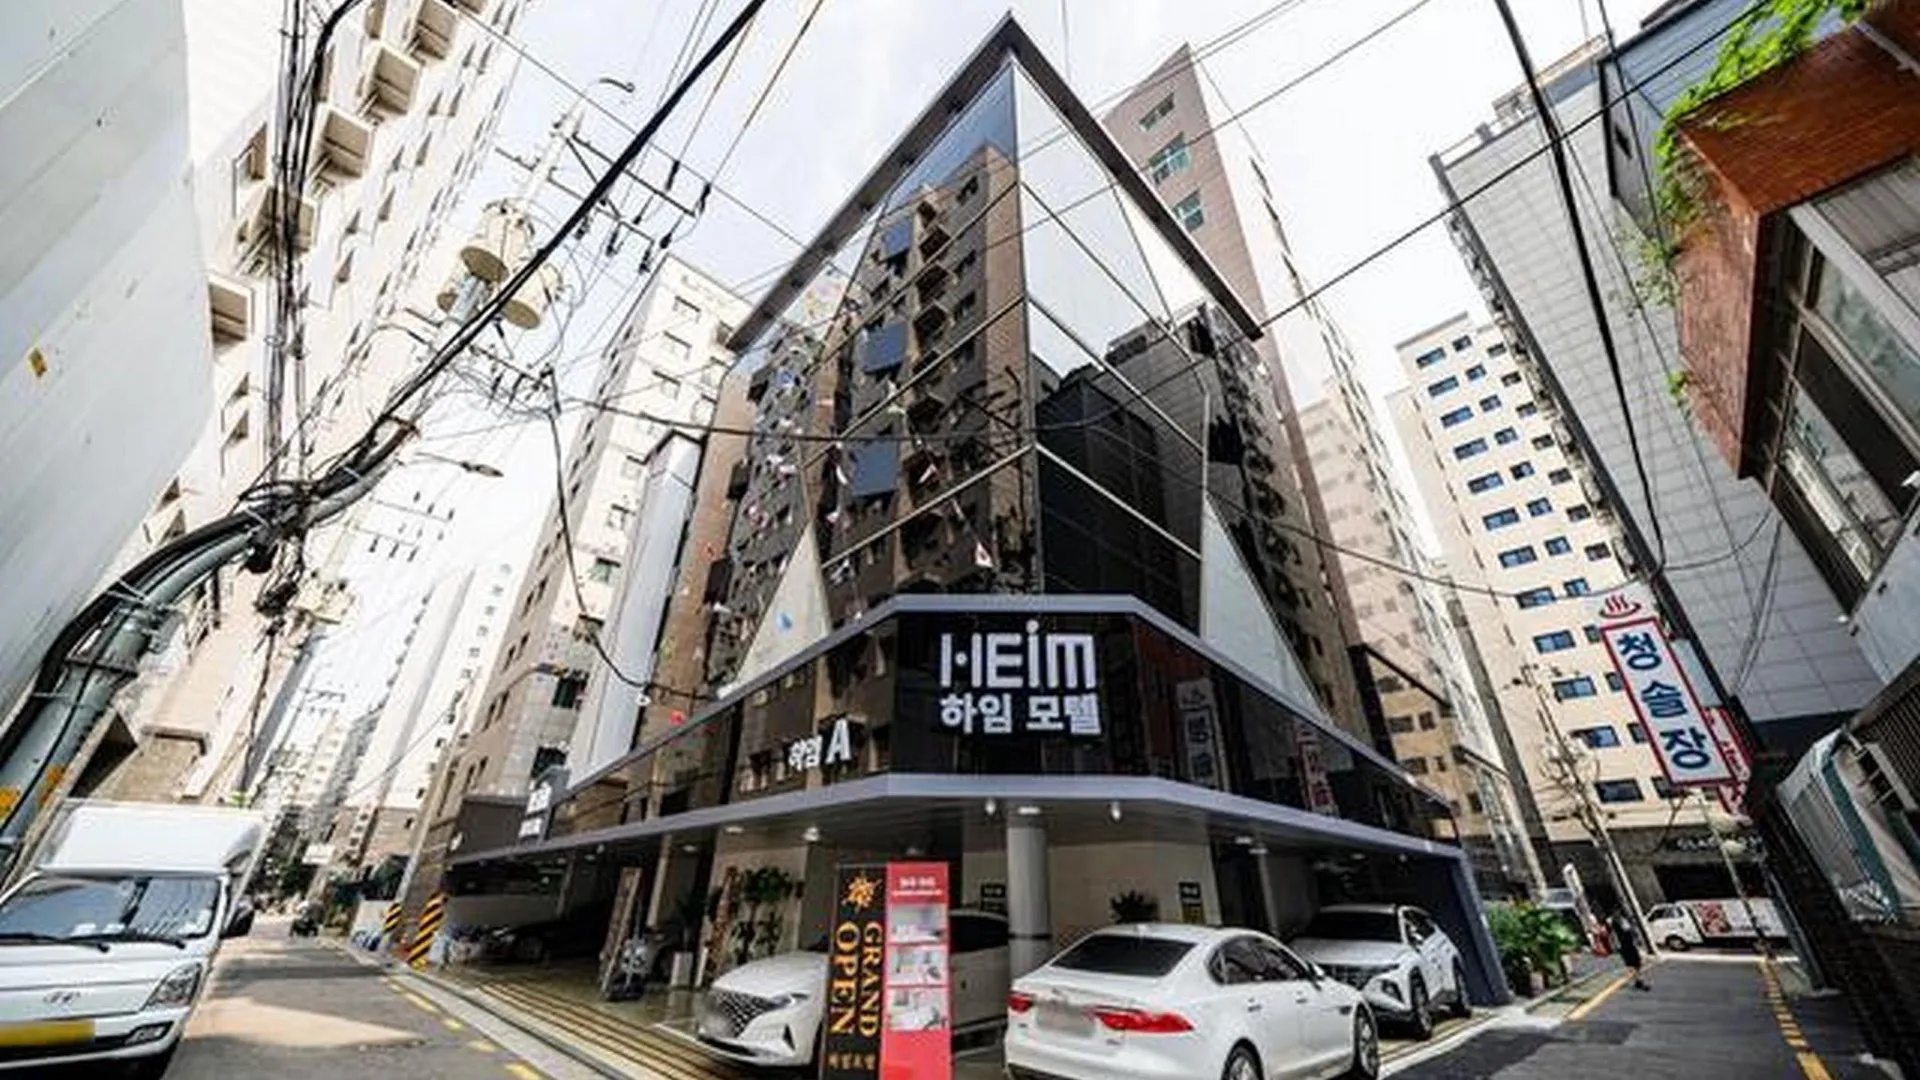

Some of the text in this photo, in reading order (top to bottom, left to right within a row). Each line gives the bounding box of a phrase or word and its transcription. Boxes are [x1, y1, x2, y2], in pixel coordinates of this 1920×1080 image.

[825, 718, 852, 764] A
[940, 692, 1102, 735] 하임 모텔
[830, 922, 861, 1036] OPEN
[859, 921, 883, 1037] GRAND
